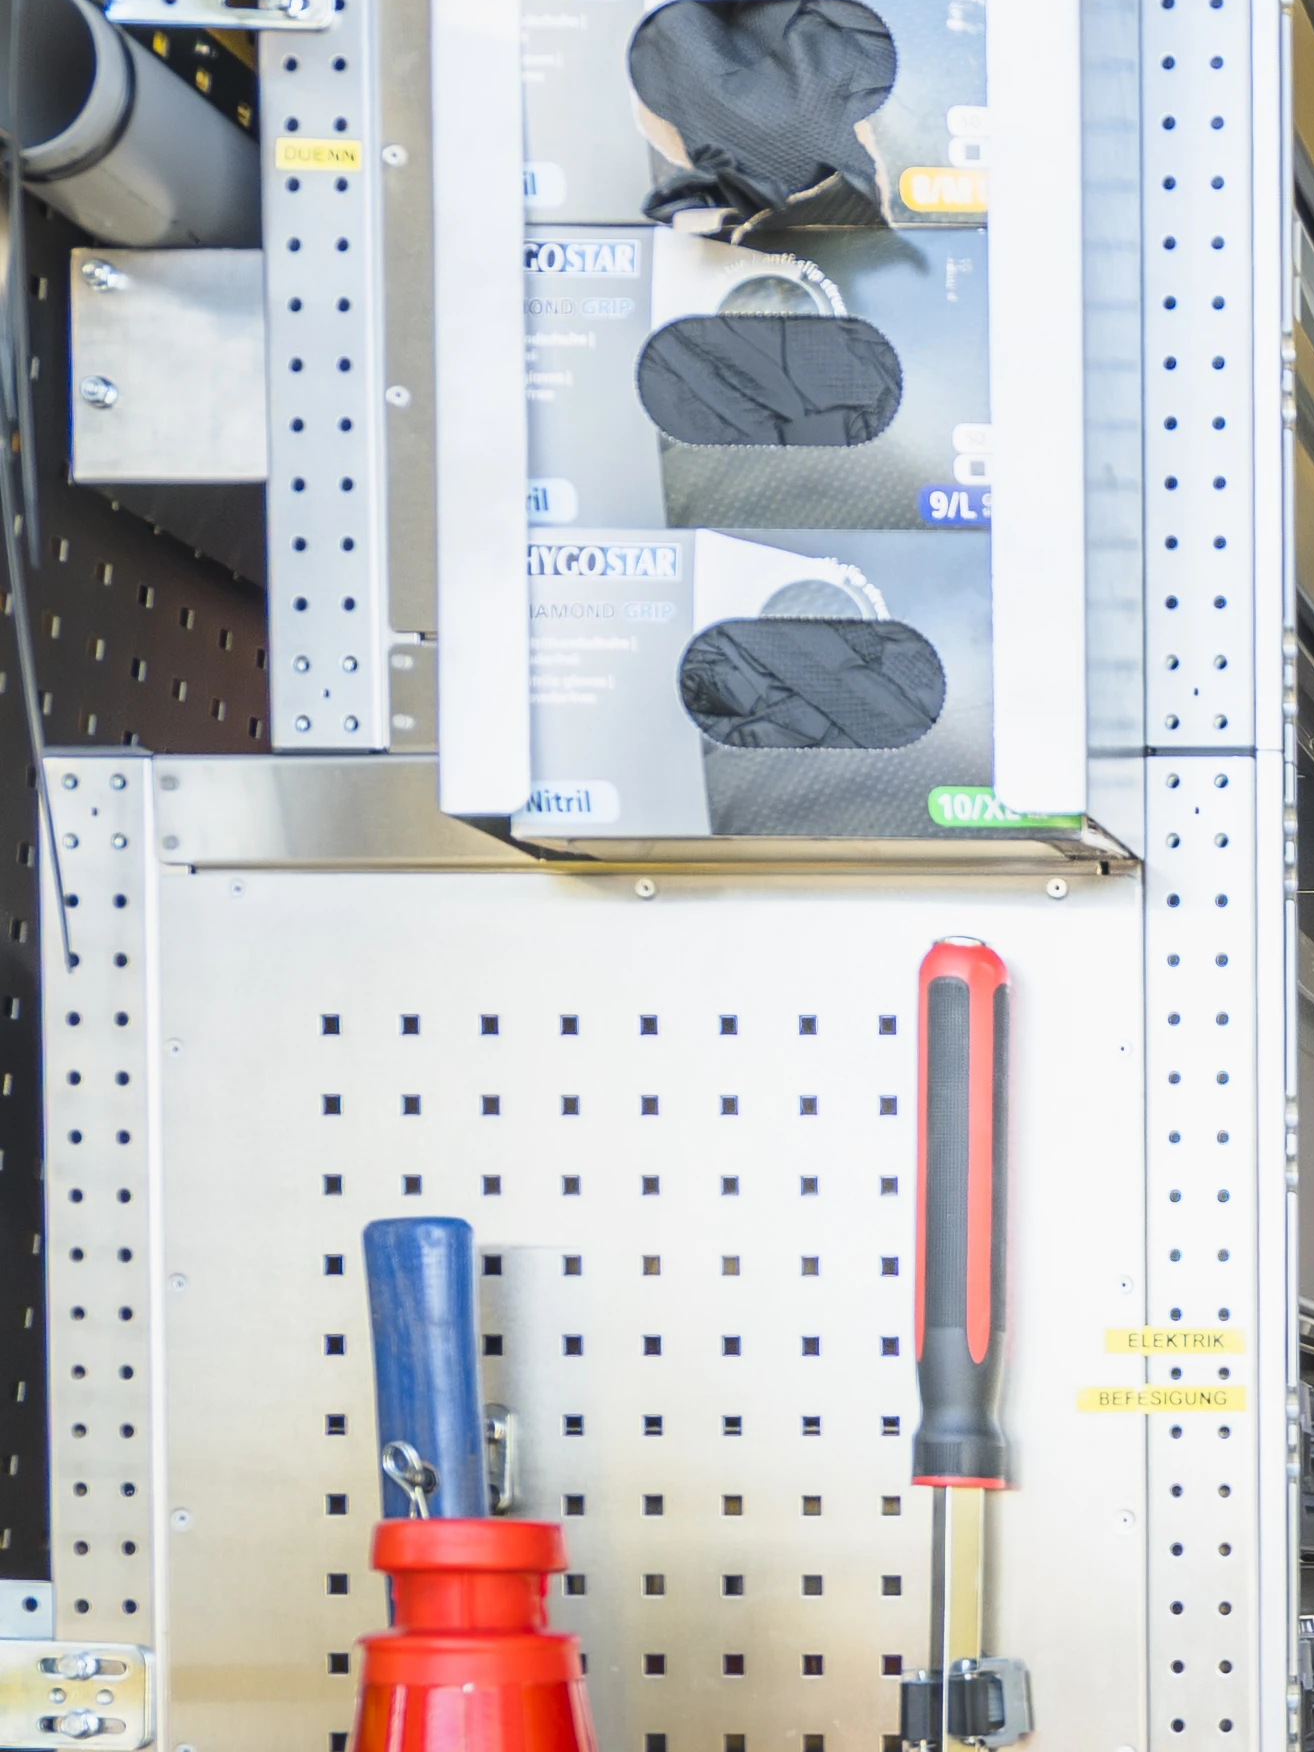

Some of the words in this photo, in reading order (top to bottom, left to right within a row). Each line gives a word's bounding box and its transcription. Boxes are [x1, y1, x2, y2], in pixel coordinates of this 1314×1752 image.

[283, 145, 357, 164] DUENN
[524, 242, 635, 273] GOSTAR
[524, 298, 575, 316] OND
[581, 298, 635, 317] GRIP
[929, 491, 977, 520] 9/L
[528, 602, 616, 619] IAMOND
[623, 602, 677, 619] GRIP
[936, 793, 1022, 822] 10/X
[1128, 1332, 1225, 1349] ELEKTRIK
[1099, 1390, 1227, 1406] BEFESIGUNG
